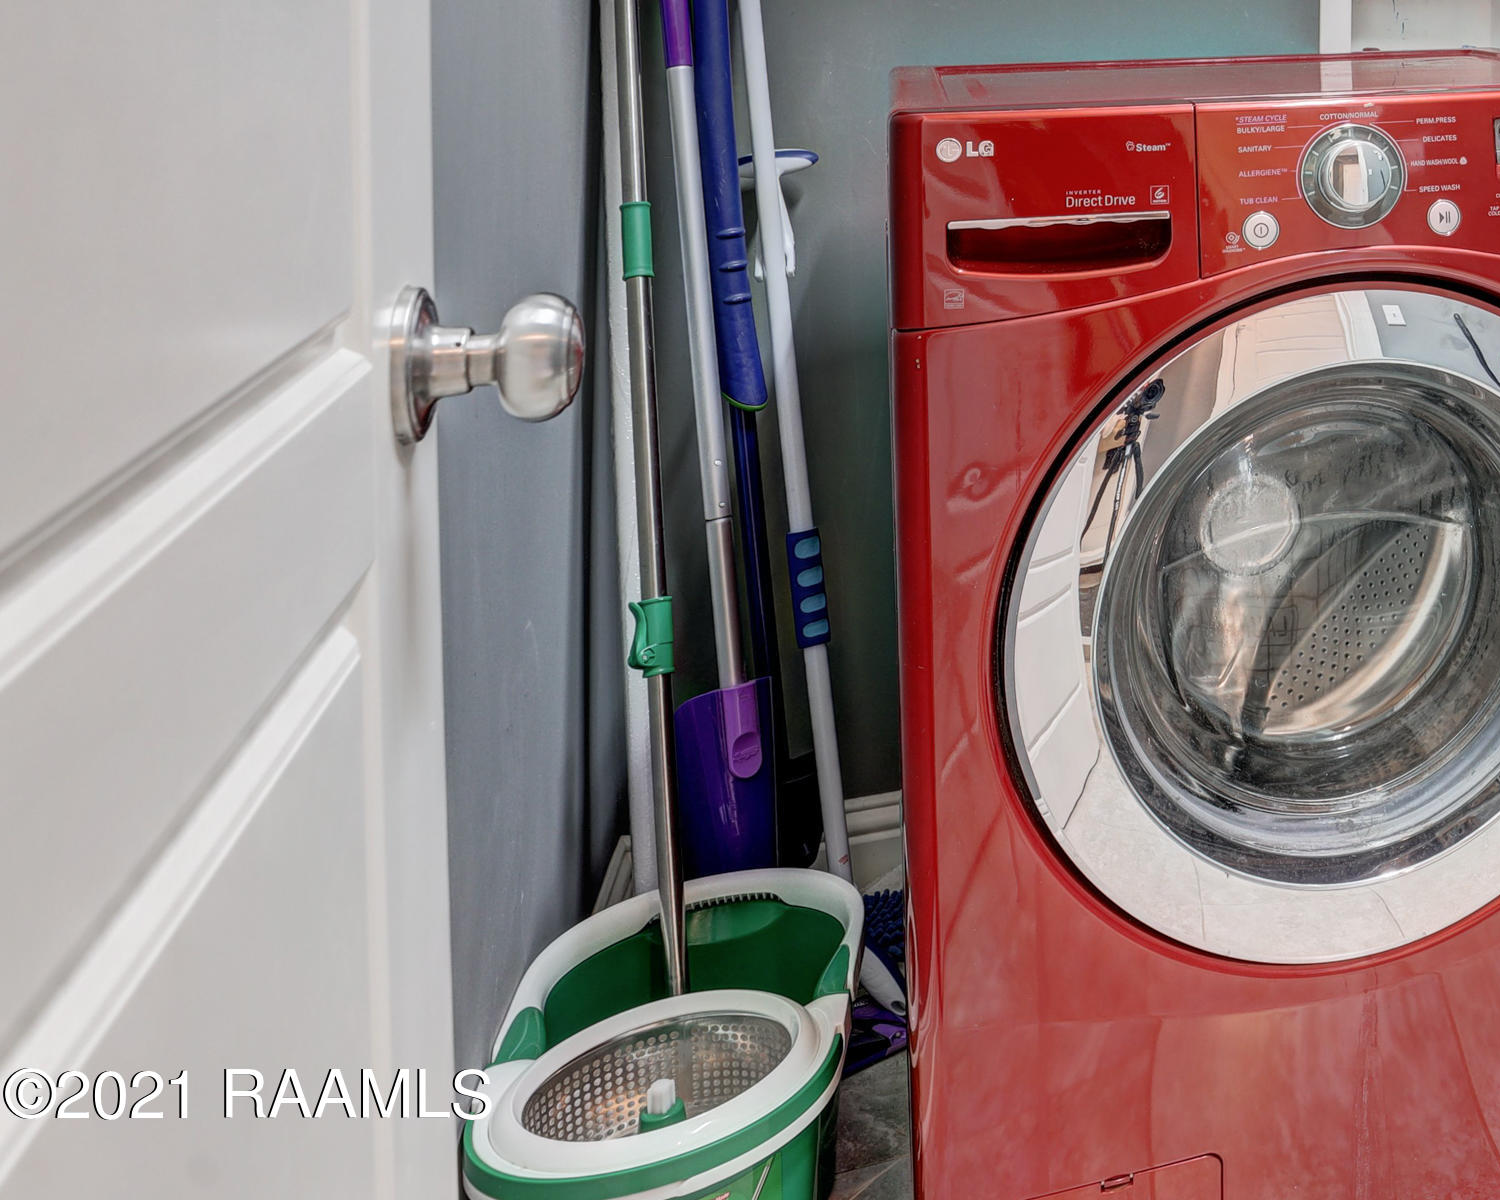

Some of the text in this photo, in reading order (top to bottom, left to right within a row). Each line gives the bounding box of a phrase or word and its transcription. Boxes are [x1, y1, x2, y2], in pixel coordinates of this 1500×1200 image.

[1265, 114, 1287, 122] CYCLE
[1319, 111, 1379, 121] COTTON/NORMAL
[1237, 125, 1285, 134] BULKY/LARGE
[1422, 134, 1457, 142] DELICATES
[966, 140, 995, 158] LG
[1238, 145, 1272, 153] SANITARY
[1427, 158, 1458, 166] WASH/WOOL
[1419, 185, 1439, 193] SPEED
[1066, 195, 1136, 208] Direct Drive
